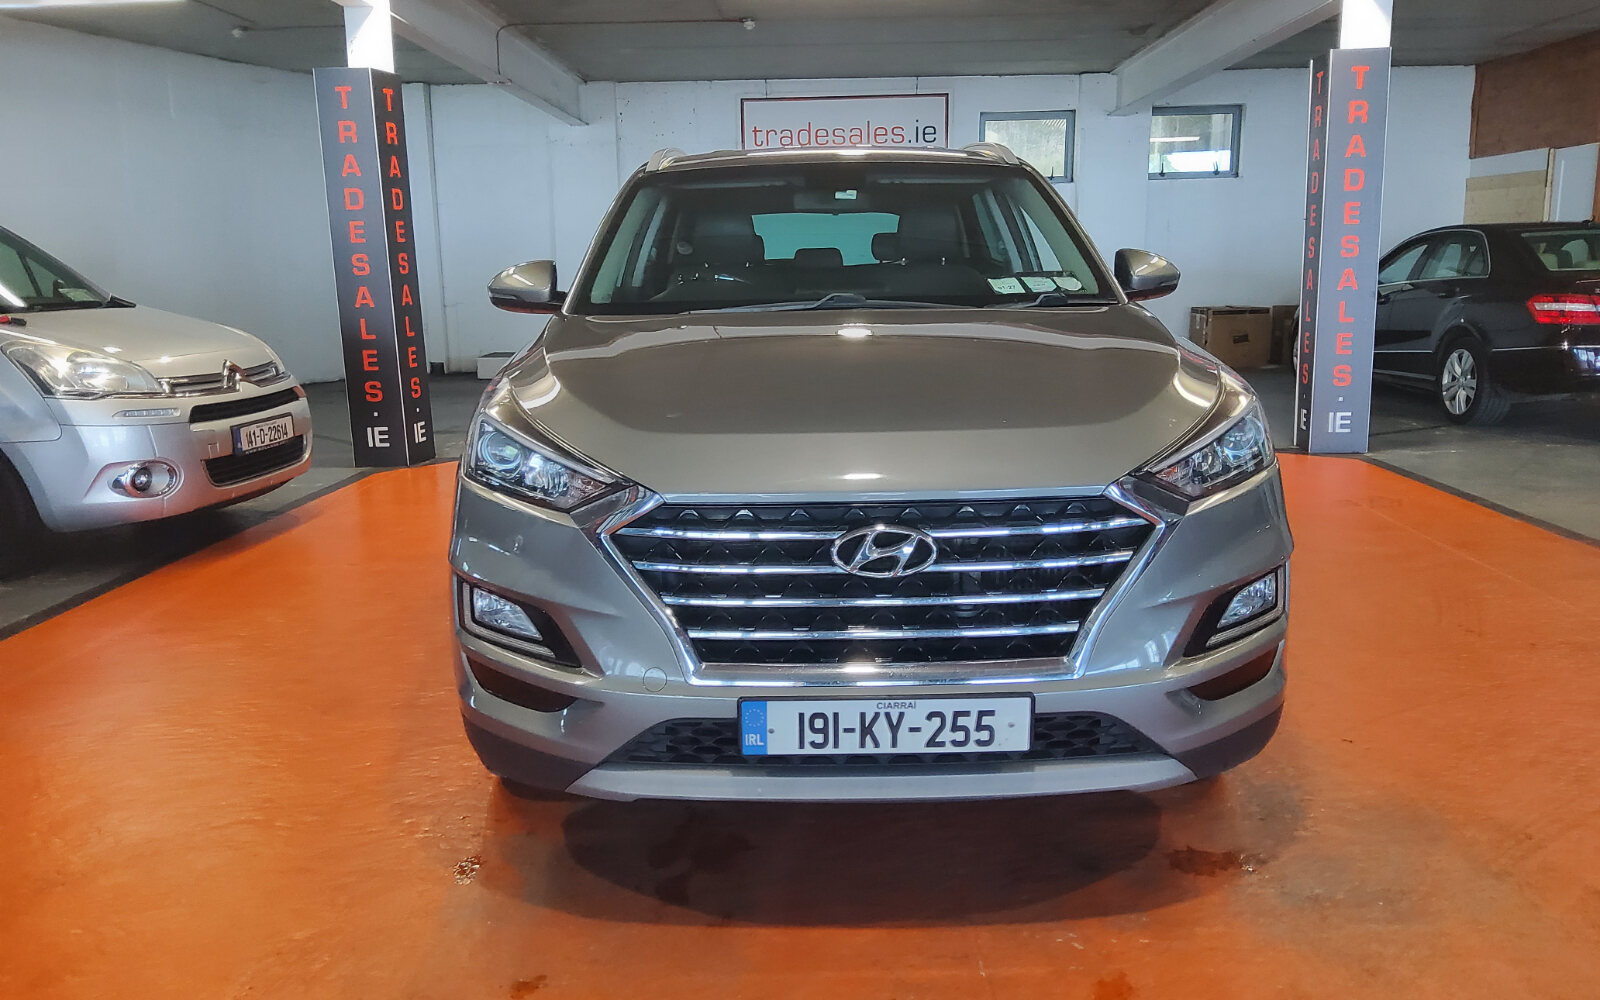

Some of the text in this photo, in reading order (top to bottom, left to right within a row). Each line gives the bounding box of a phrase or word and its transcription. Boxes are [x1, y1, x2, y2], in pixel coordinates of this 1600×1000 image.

[752, 119, 937, 147] tradesales.ie
[246, 423, 288, 447] 141-D-22614
[745, 733, 764, 746] IRL
[798, 710, 995, 749] 191-KY-255
